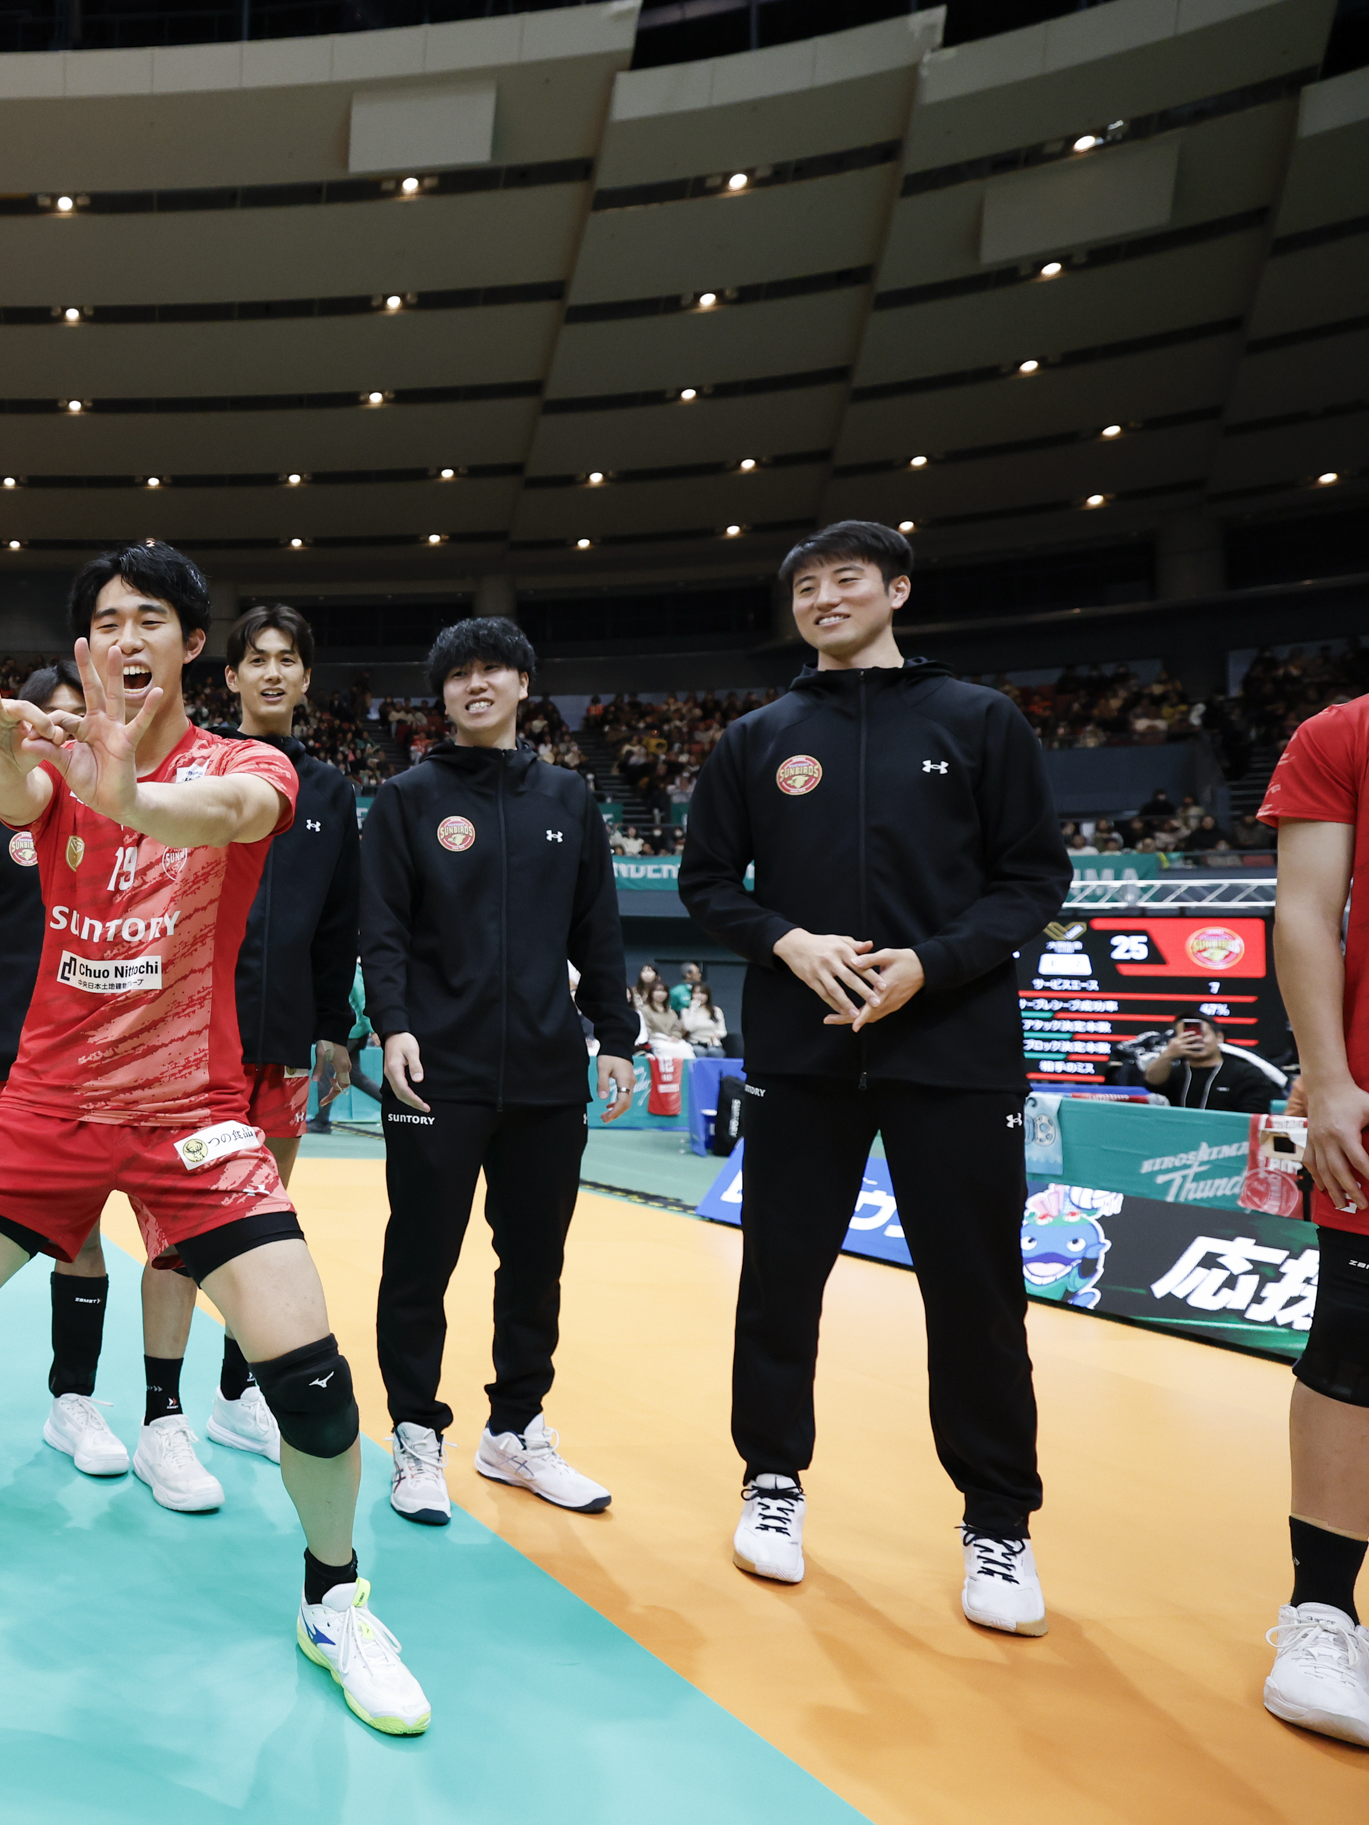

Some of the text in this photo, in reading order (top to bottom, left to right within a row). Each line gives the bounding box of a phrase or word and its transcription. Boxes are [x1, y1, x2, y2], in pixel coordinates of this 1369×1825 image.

[779, 765, 819, 782] SUNBIRDS
[440, 826, 473, 840] SUNBIRDS
[11, 841, 35, 853] SUNBIR
[107, 846, 138, 891] 19
[49, 905, 182, 943] SUNTORY
[1110, 935, 1149, 960] 25
[79, 961, 159, 979] Chuo Nittochi
[388, 1113, 435, 1125] SUNTORY
[208, 1126, 254, 1147] つの食品
[1155, 1142, 1249, 1202] Thund
